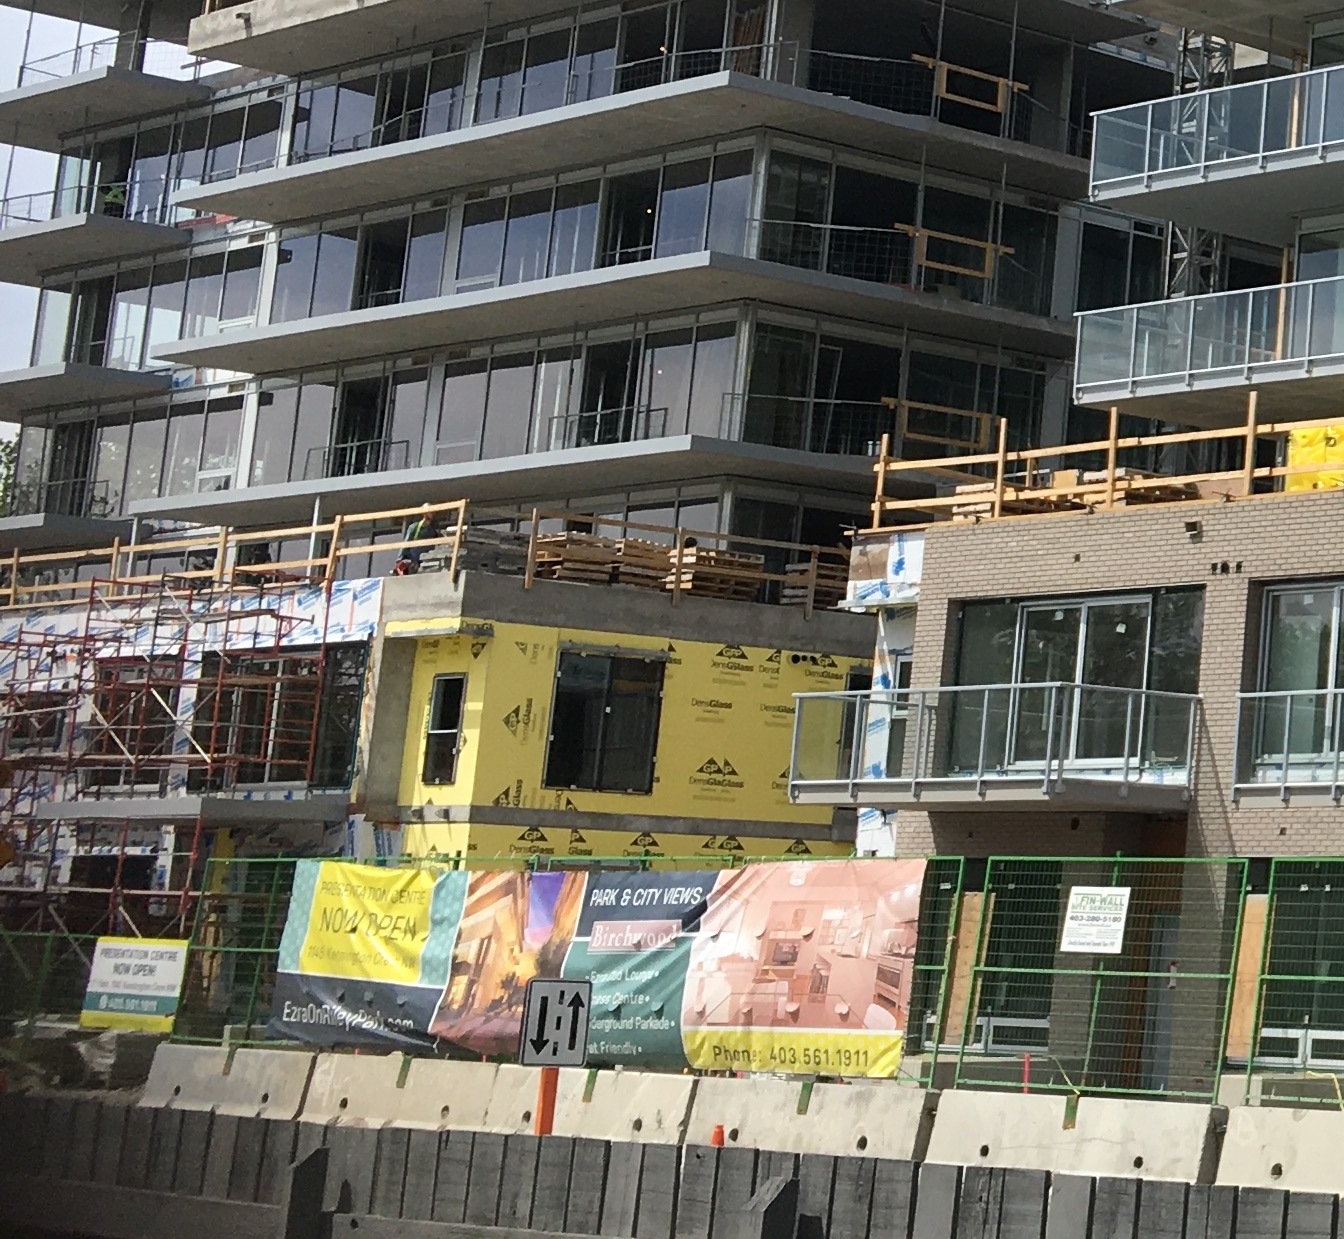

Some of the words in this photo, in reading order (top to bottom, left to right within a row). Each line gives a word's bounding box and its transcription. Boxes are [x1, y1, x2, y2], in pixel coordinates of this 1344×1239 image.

[524, 831, 541, 840] GP
[637, 836, 653, 846] GP
[590, 888, 617, 907] PARK
[620, 888, 632, 906] &
[632, 888, 662, 906] CITY
[663, 886, 703, 905] VIEWS
[590, 1016, 634, 1032] derground
[635, 1016, 670, 1030] Parkade
[770, 1046, 869, 1067] 403.561.1911
